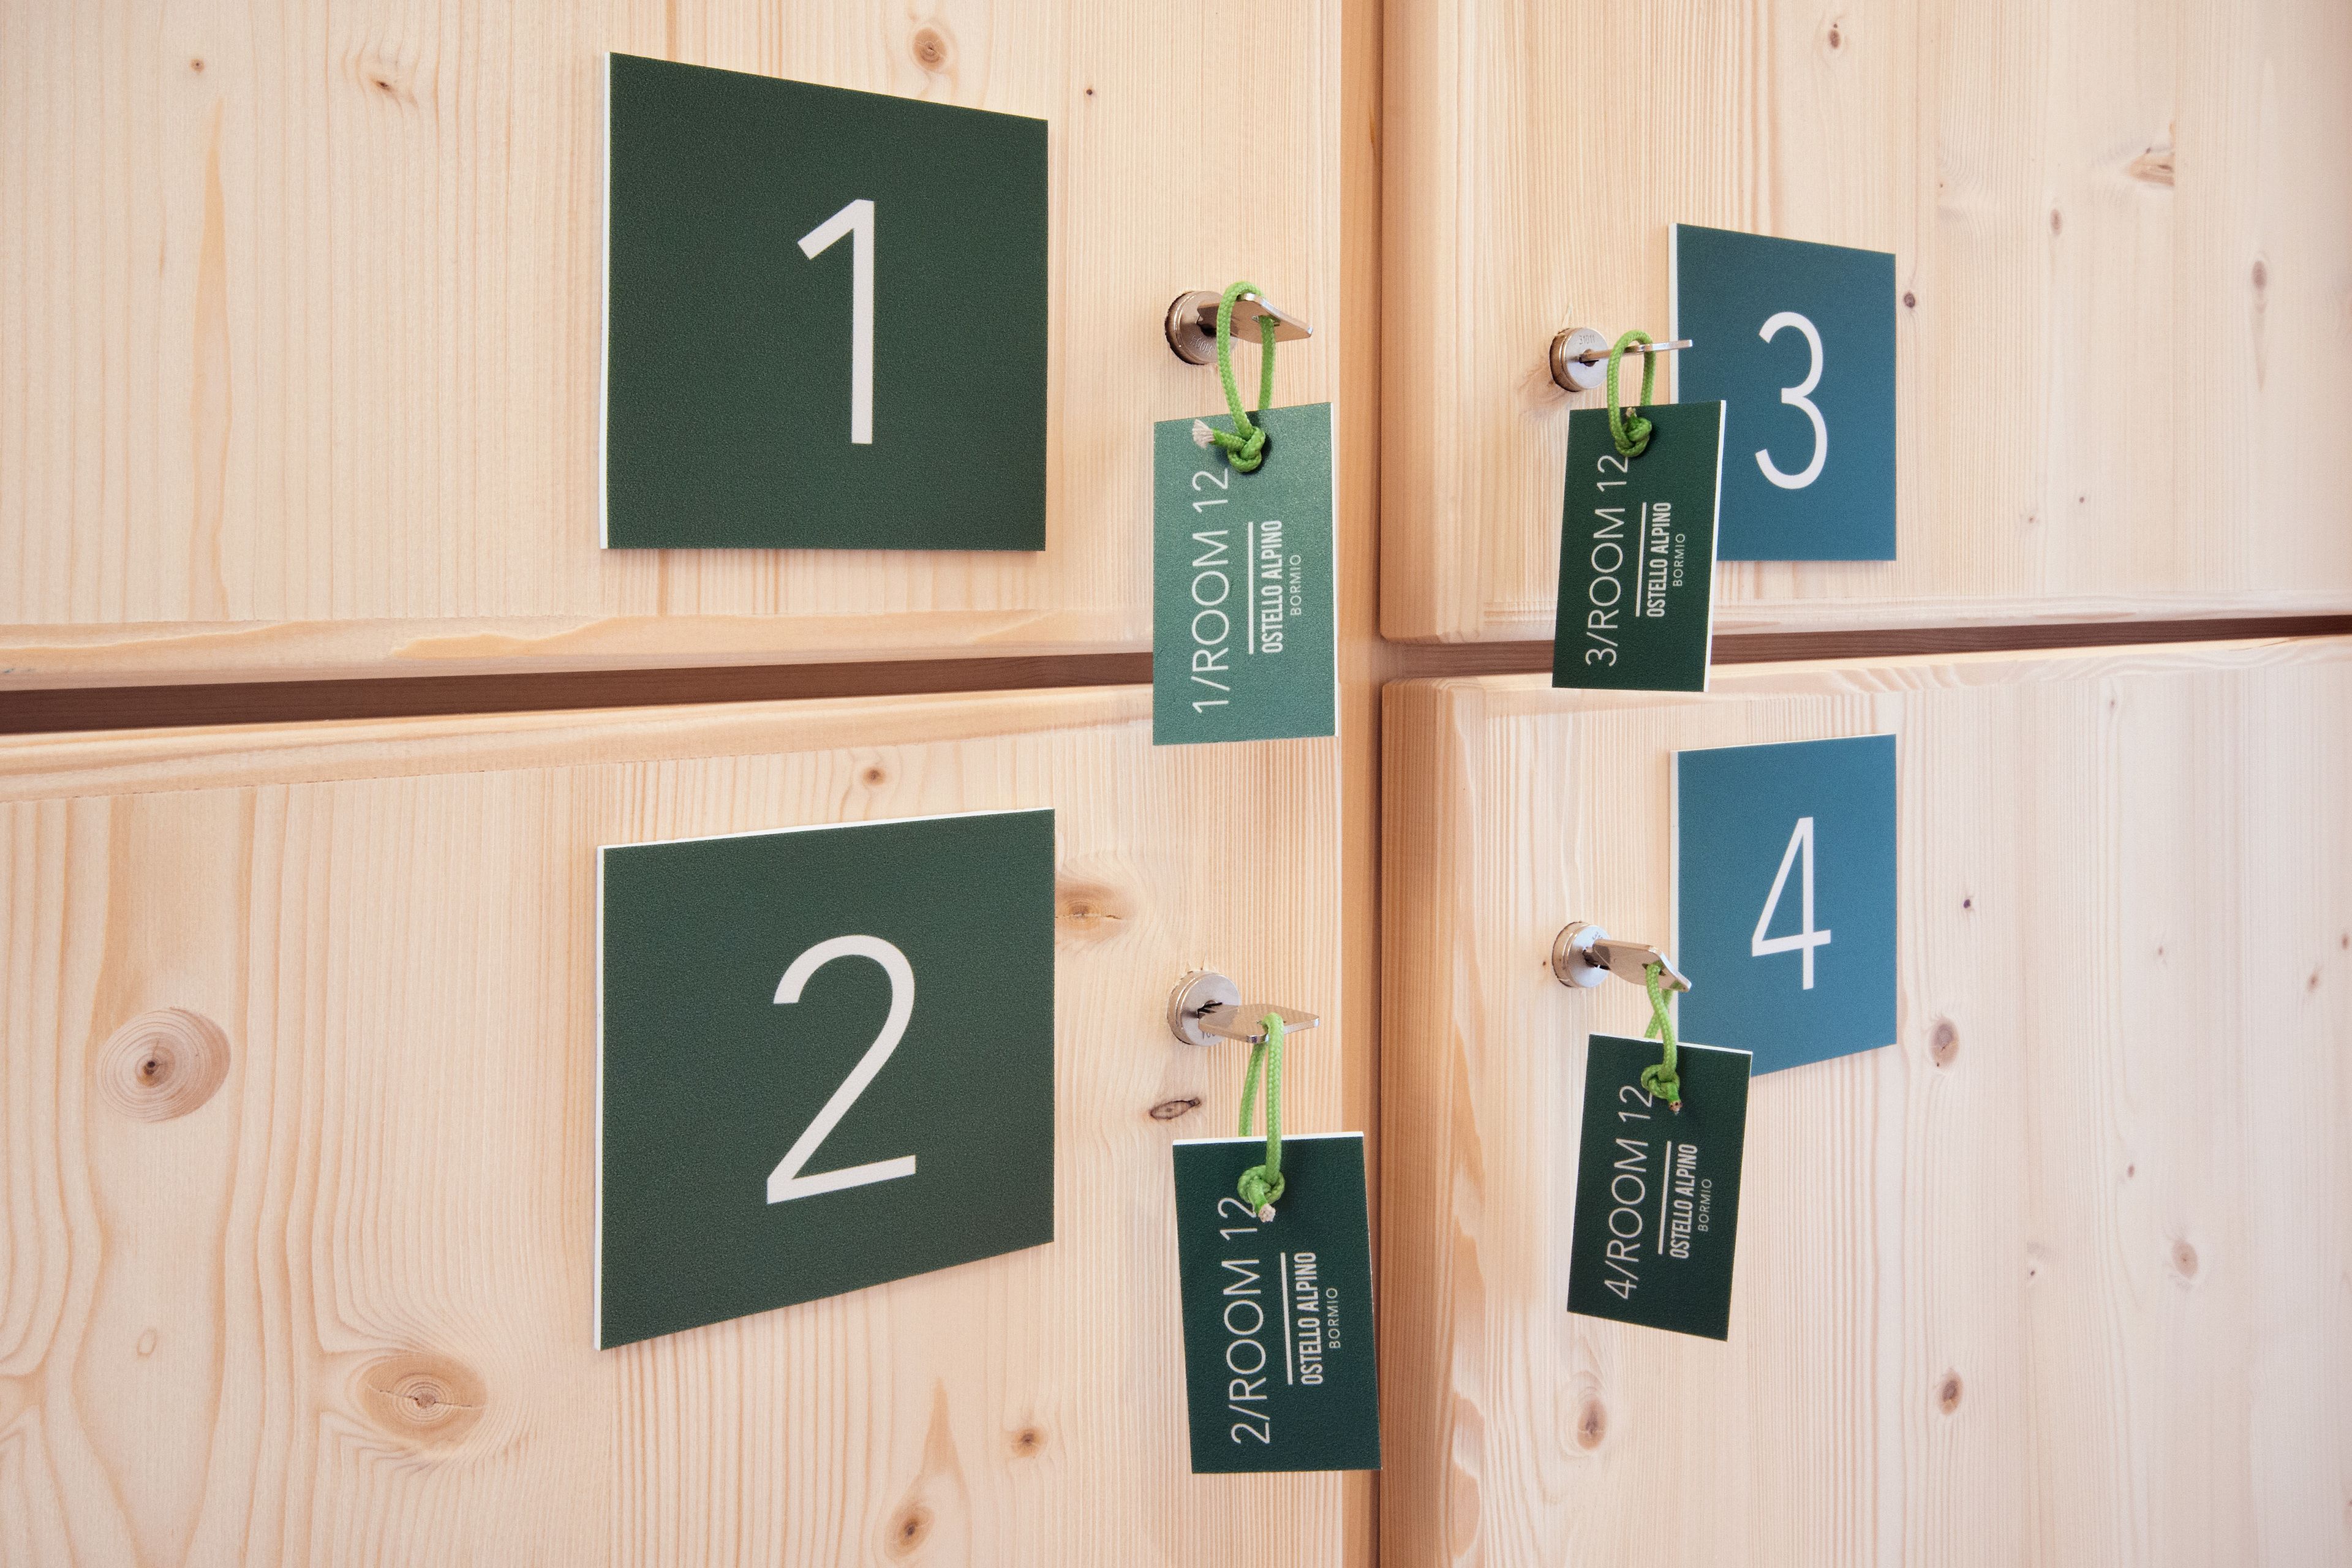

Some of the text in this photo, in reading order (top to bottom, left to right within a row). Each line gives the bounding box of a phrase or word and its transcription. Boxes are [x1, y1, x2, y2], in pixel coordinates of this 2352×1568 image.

[798, 200, 874, 444] 1
[1755, 312, 1827, 489] 3
[1191, 469, 1229, 713] 1/ROOM 12
[1261, 521, 1283, 652] OSTELLO ALPINO
[1290, 555, 1301, 615] BORMIO
[1586, 456, 1628, 666] 3/ROOM 12
[1647, 503, 1671, 617] OSTELLO ALPINO
[1673, 534, 1685, 586] BORMIO
[1752, 817, 1831, 989] 4
[767, 935, 916, 1204] 2
[1605, 1086, 1652, 1299] 4/ROOM 12
[1670, 1144, 1697, 1258] OSTELLO ALPINO
[1698, 1179, 1712, 1231] BORMIO
[1218, 1197, 1270, 1444] 2/ROOM 12
[1294, 1253, 1323, 1384] OSTELLO ALPINO
[1326, 1288, 1340, 1348] BORMIO
